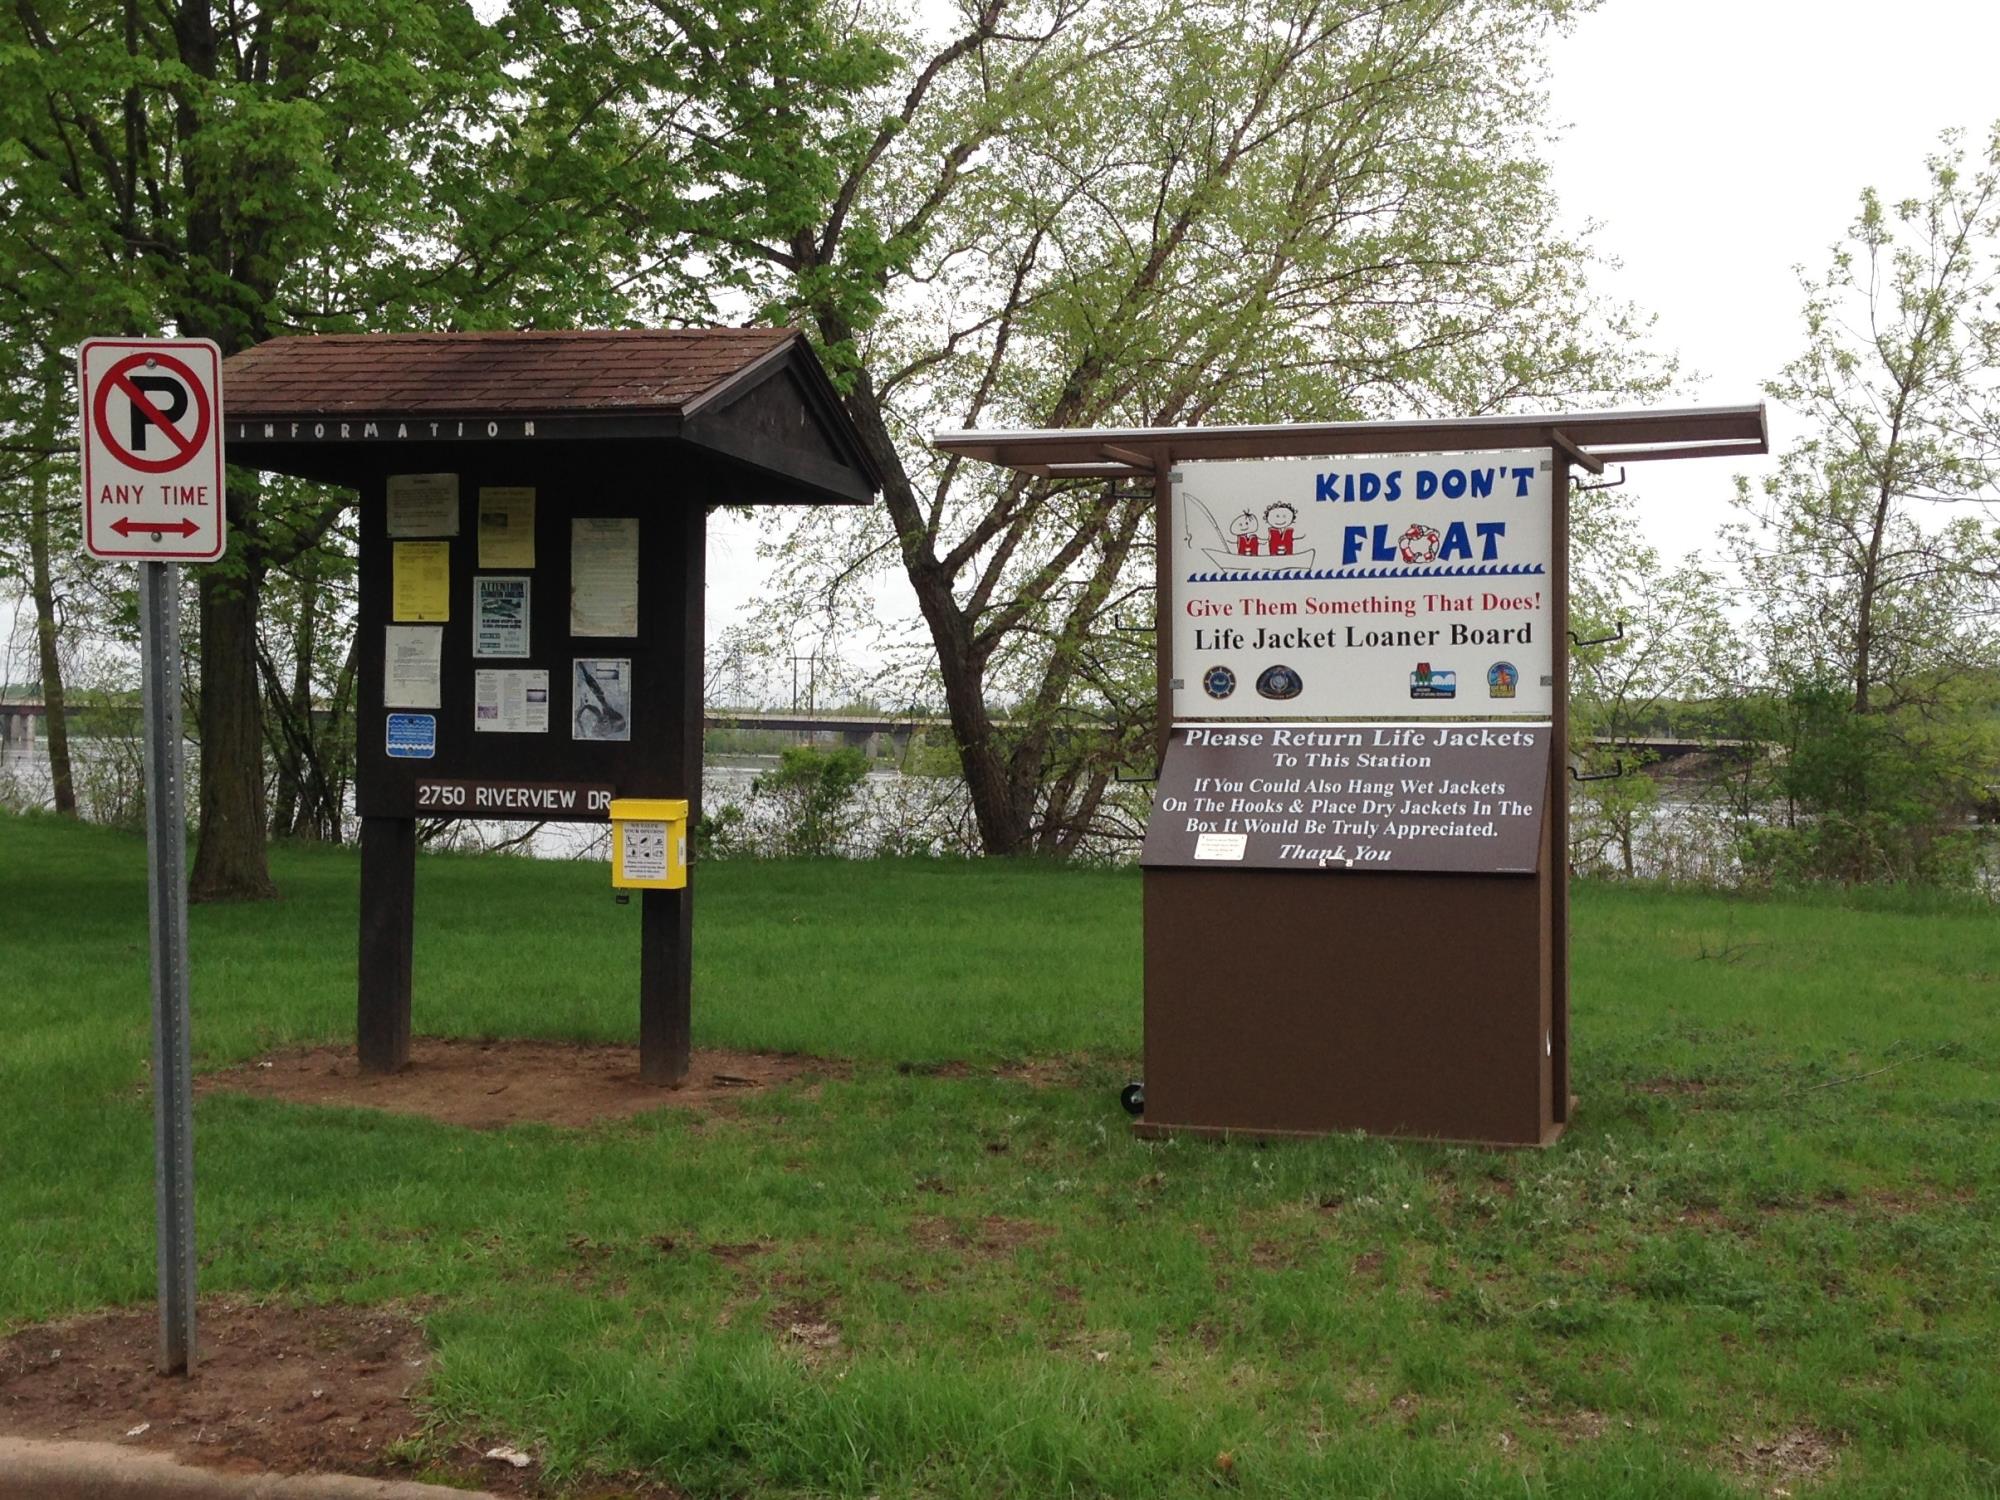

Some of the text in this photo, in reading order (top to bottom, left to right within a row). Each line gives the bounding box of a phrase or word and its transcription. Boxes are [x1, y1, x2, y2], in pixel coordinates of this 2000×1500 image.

[129, 375, 188, 451] P
[240, 421, 536, 439] INFORMATION
[100, 484, 209, 506] ANY TIME
[1315, 466, 1535, 503] KIDS DON'T
[1186, 591, 1542, 618] Give Them Something That Does!
[1194, 622, 1533, 652] Life Jacket Loaner Board
[1183, 729, 1536, 747] Please Return Life Jackets
[1273, 753, 1432, 768] To This Station
[418, 785, 612, 810] 2750 RIVERVIEW DR
[1194, 777, 1506, 798] If You Could Also Hang Wet Jackets
[1162, 797, 1533, 818] On The Hooks & Place Dry Jackets In The
[1186, 817, 1499, 840] Box It Would Be Truly Appreciated.
[1279, 844, 1393, 862] Thank You
